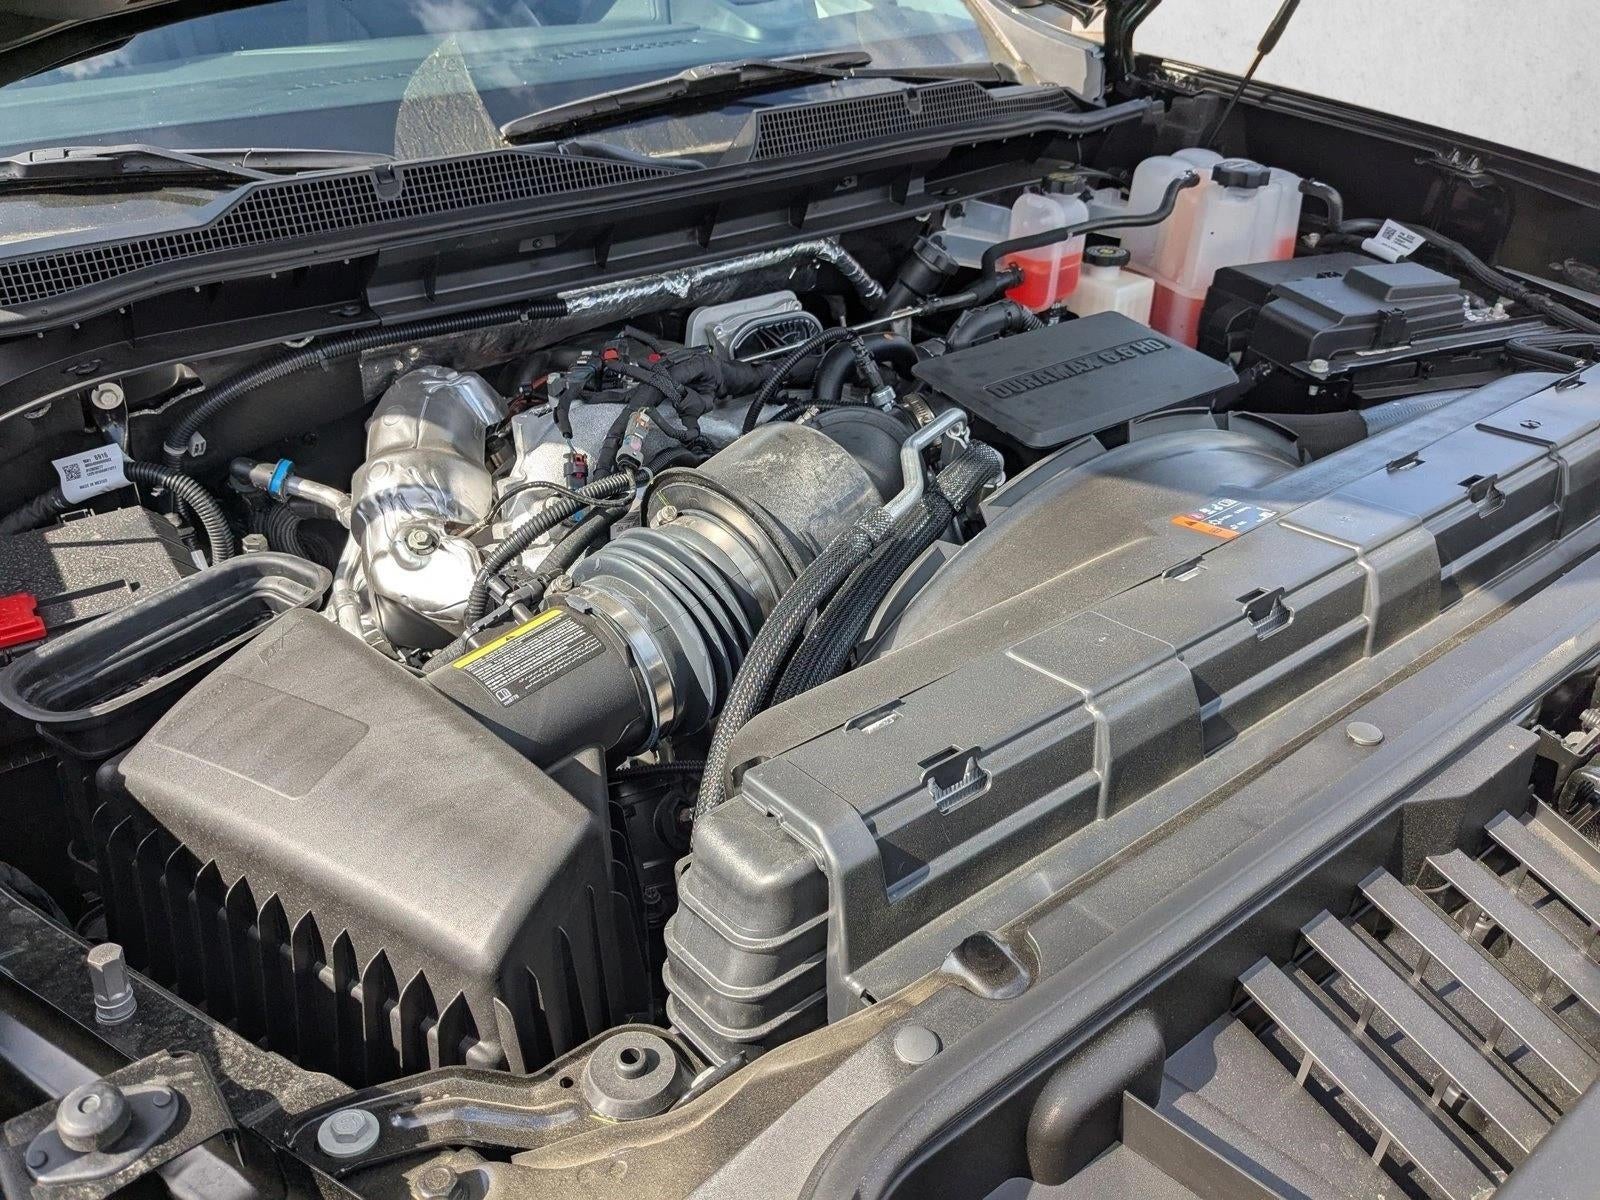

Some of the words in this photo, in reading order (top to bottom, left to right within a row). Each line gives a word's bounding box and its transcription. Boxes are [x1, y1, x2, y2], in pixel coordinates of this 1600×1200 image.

[990, 356, 1100, 398] DURAMAX
[1101, 346, 1137, 364] 6.6
[1135, 339, 1166, 355] HD
